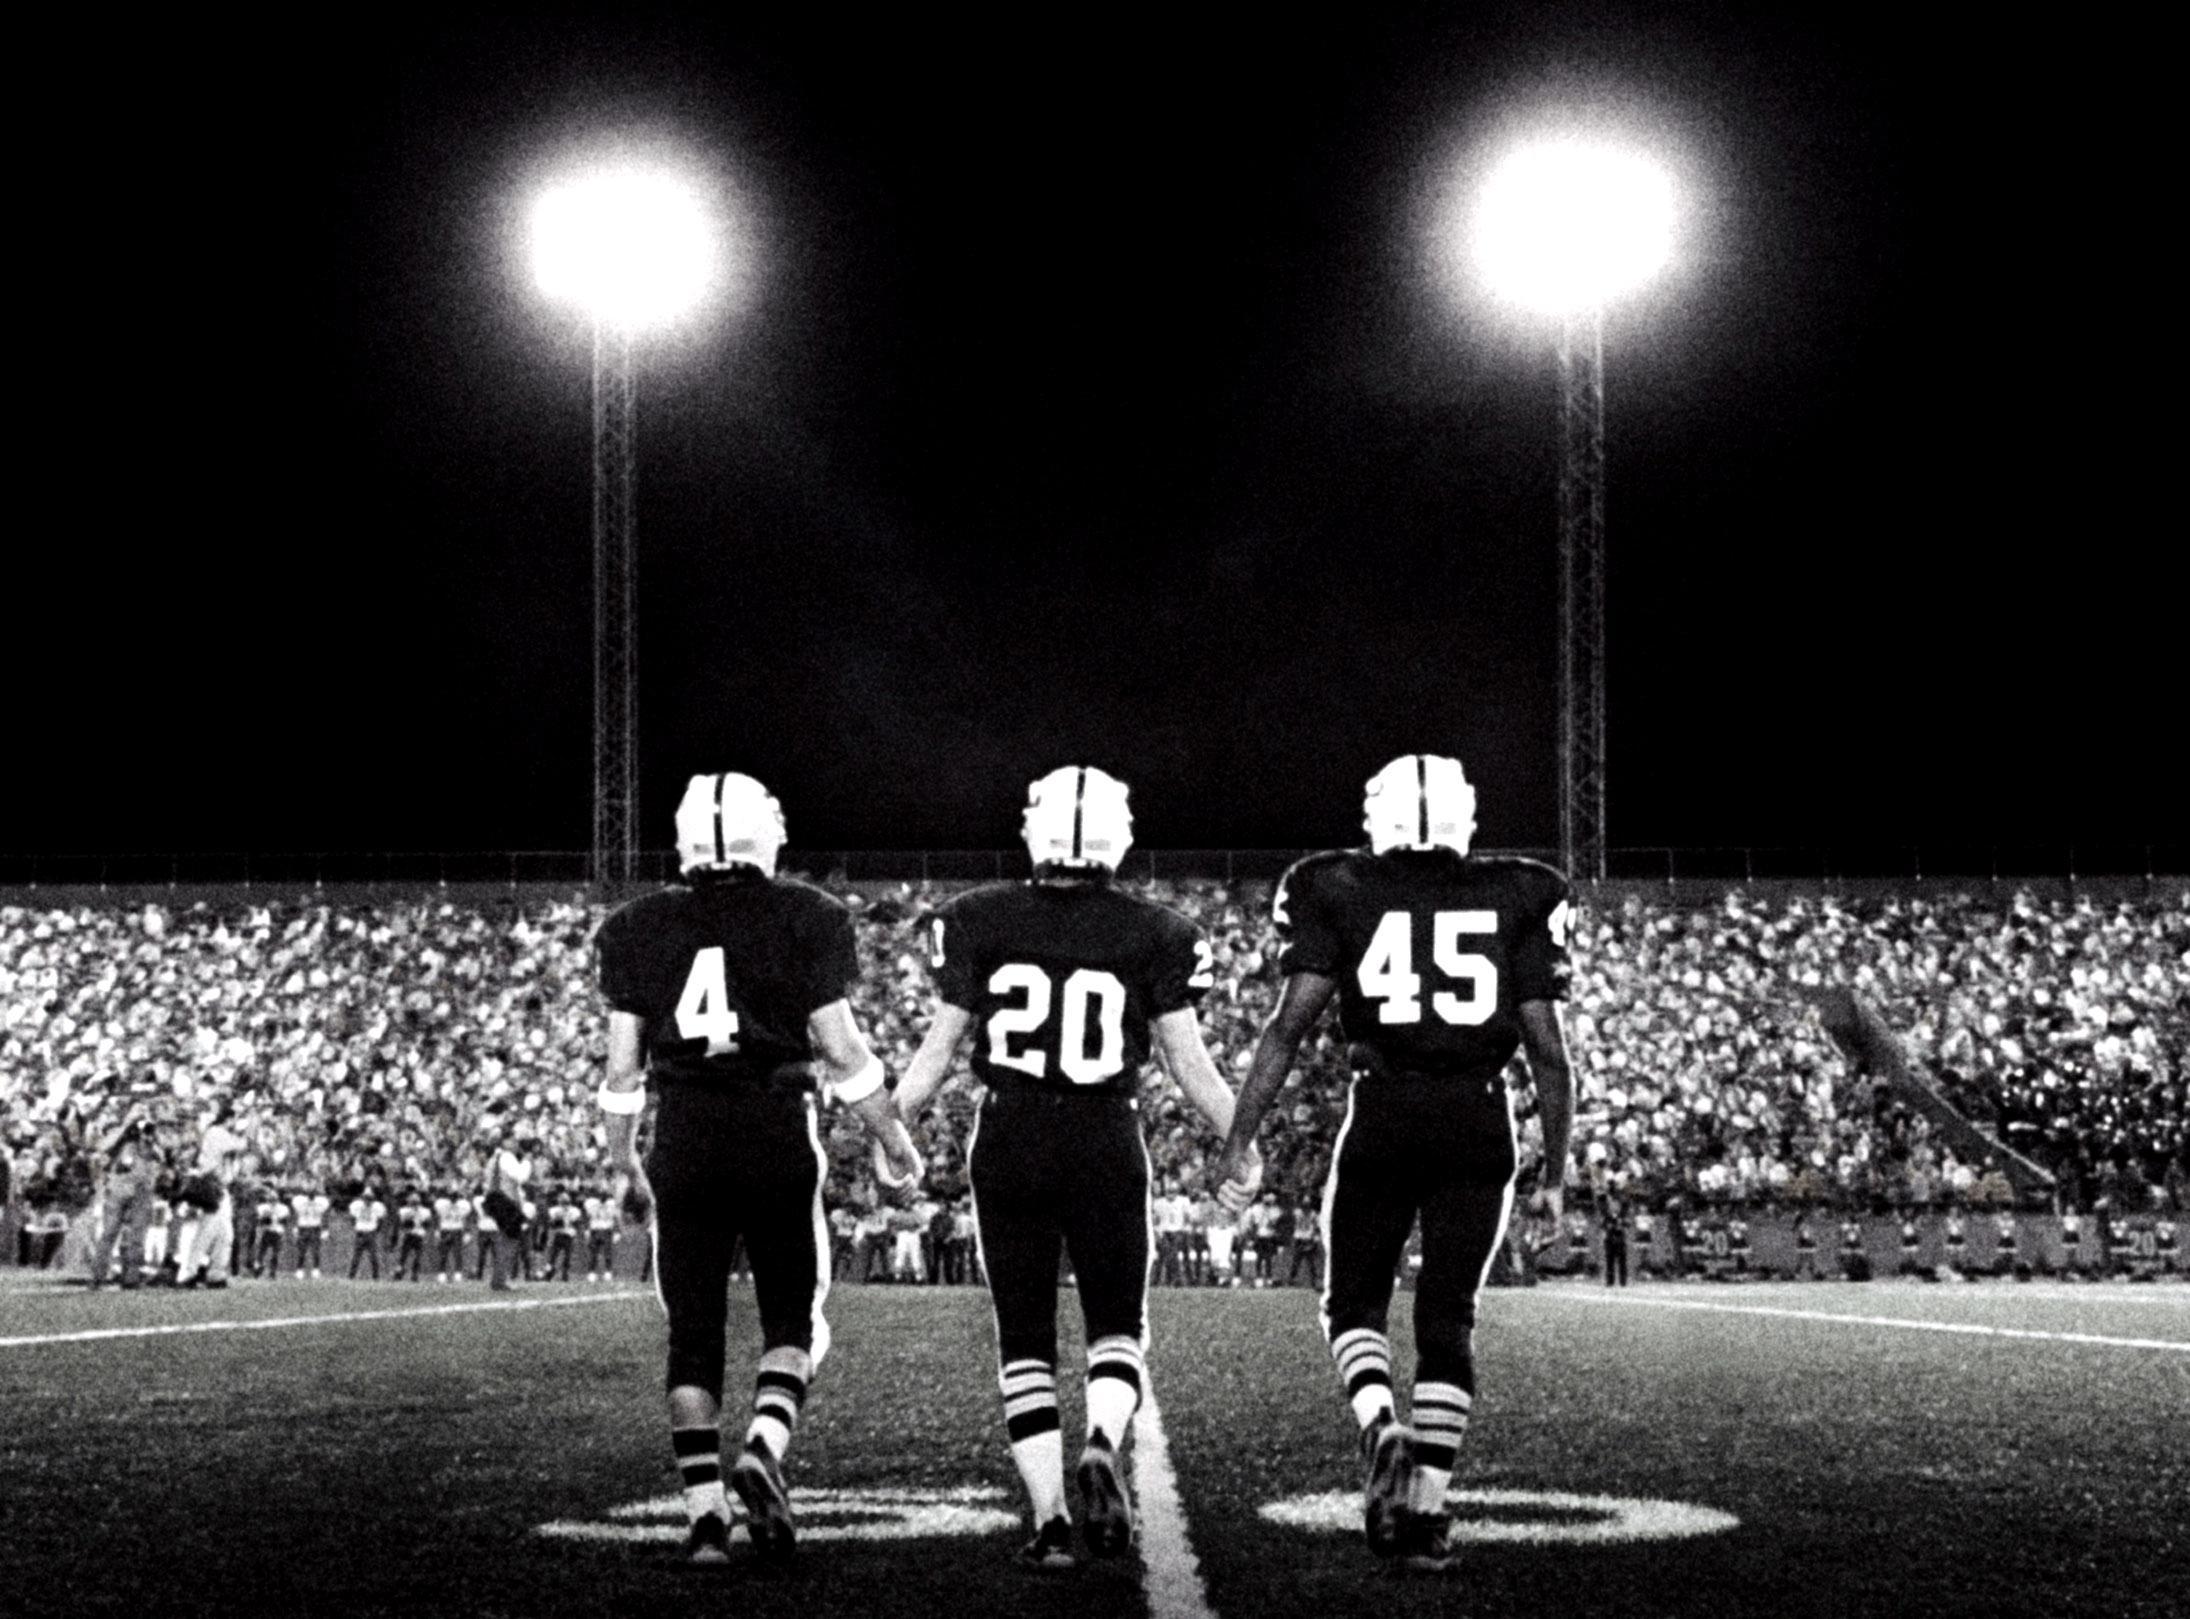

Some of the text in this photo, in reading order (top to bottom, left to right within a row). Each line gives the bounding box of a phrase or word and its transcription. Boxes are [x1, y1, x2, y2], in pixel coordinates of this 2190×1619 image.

[674, 945, 740, 1057] 4
[987, 963, 1126, 1084] 20
[1357, 910, 1498, 1025] 45
